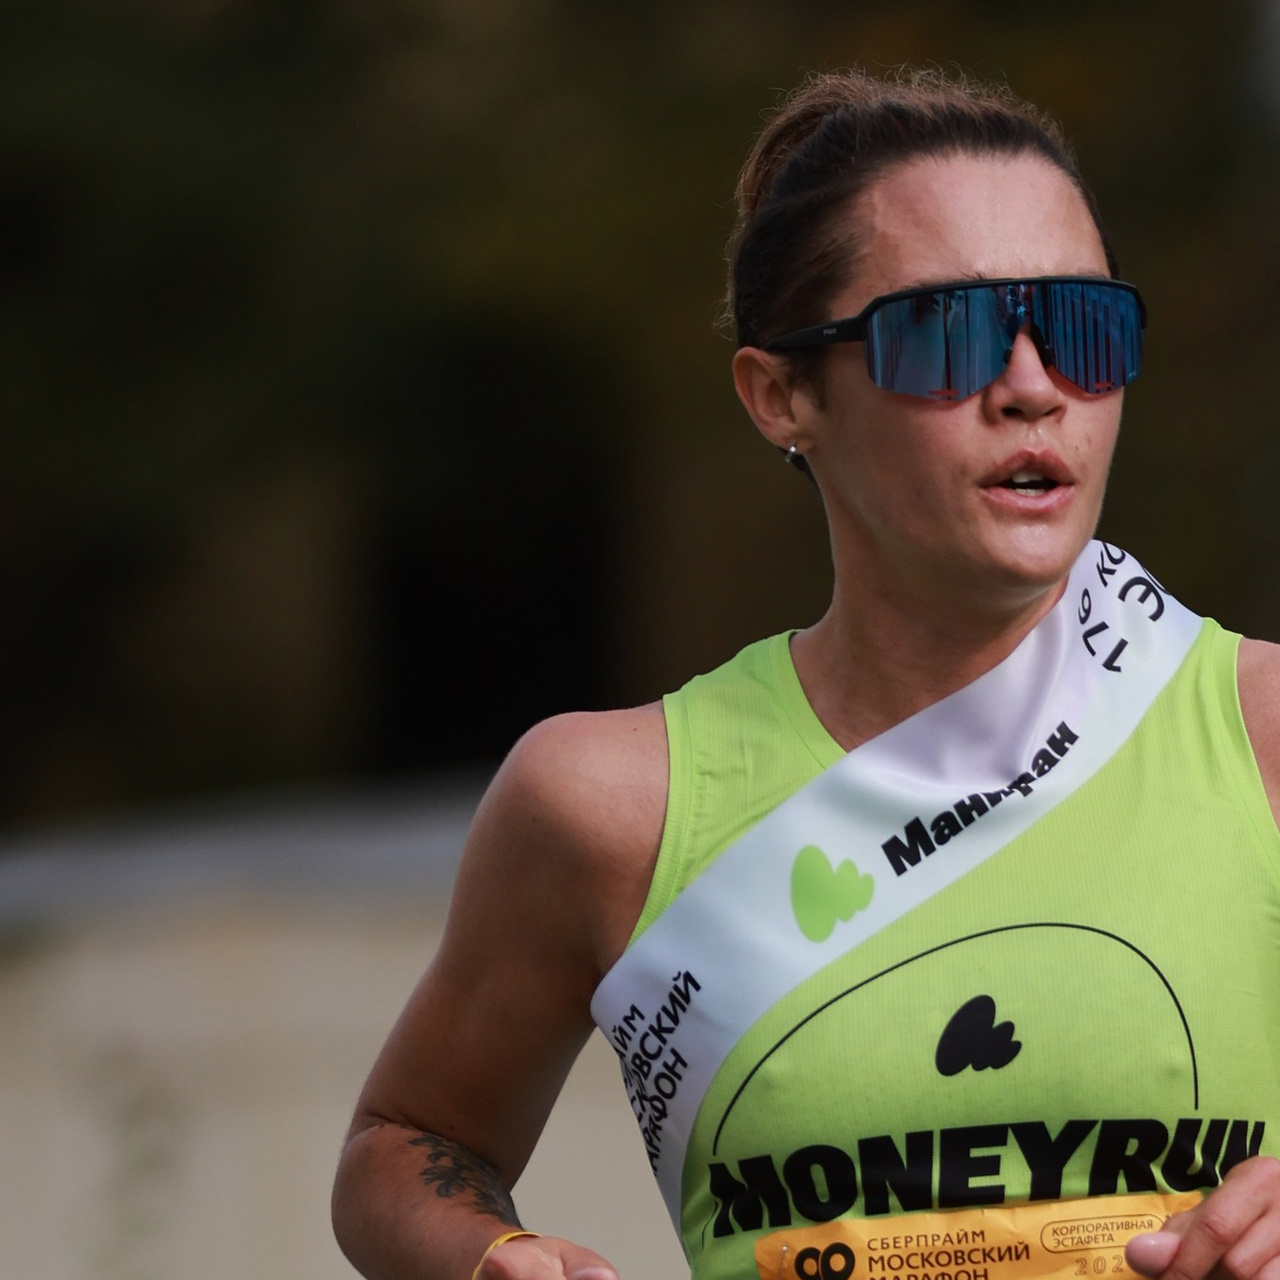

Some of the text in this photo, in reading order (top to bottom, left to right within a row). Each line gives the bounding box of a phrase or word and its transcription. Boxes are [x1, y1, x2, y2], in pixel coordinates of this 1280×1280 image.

[1051, 1219, 1154, 1237] КОРПОРАТИВНАЯ
[867, 1228, 986, 1251] СБЕРПРАЙМ
[1053, 1233, 1115, 1248] ЭСТАФЕТА
[868, 1240, 1031, 1273] МОСКОВСКИЙ
[1074, 1254, 1125, 1276] 202
